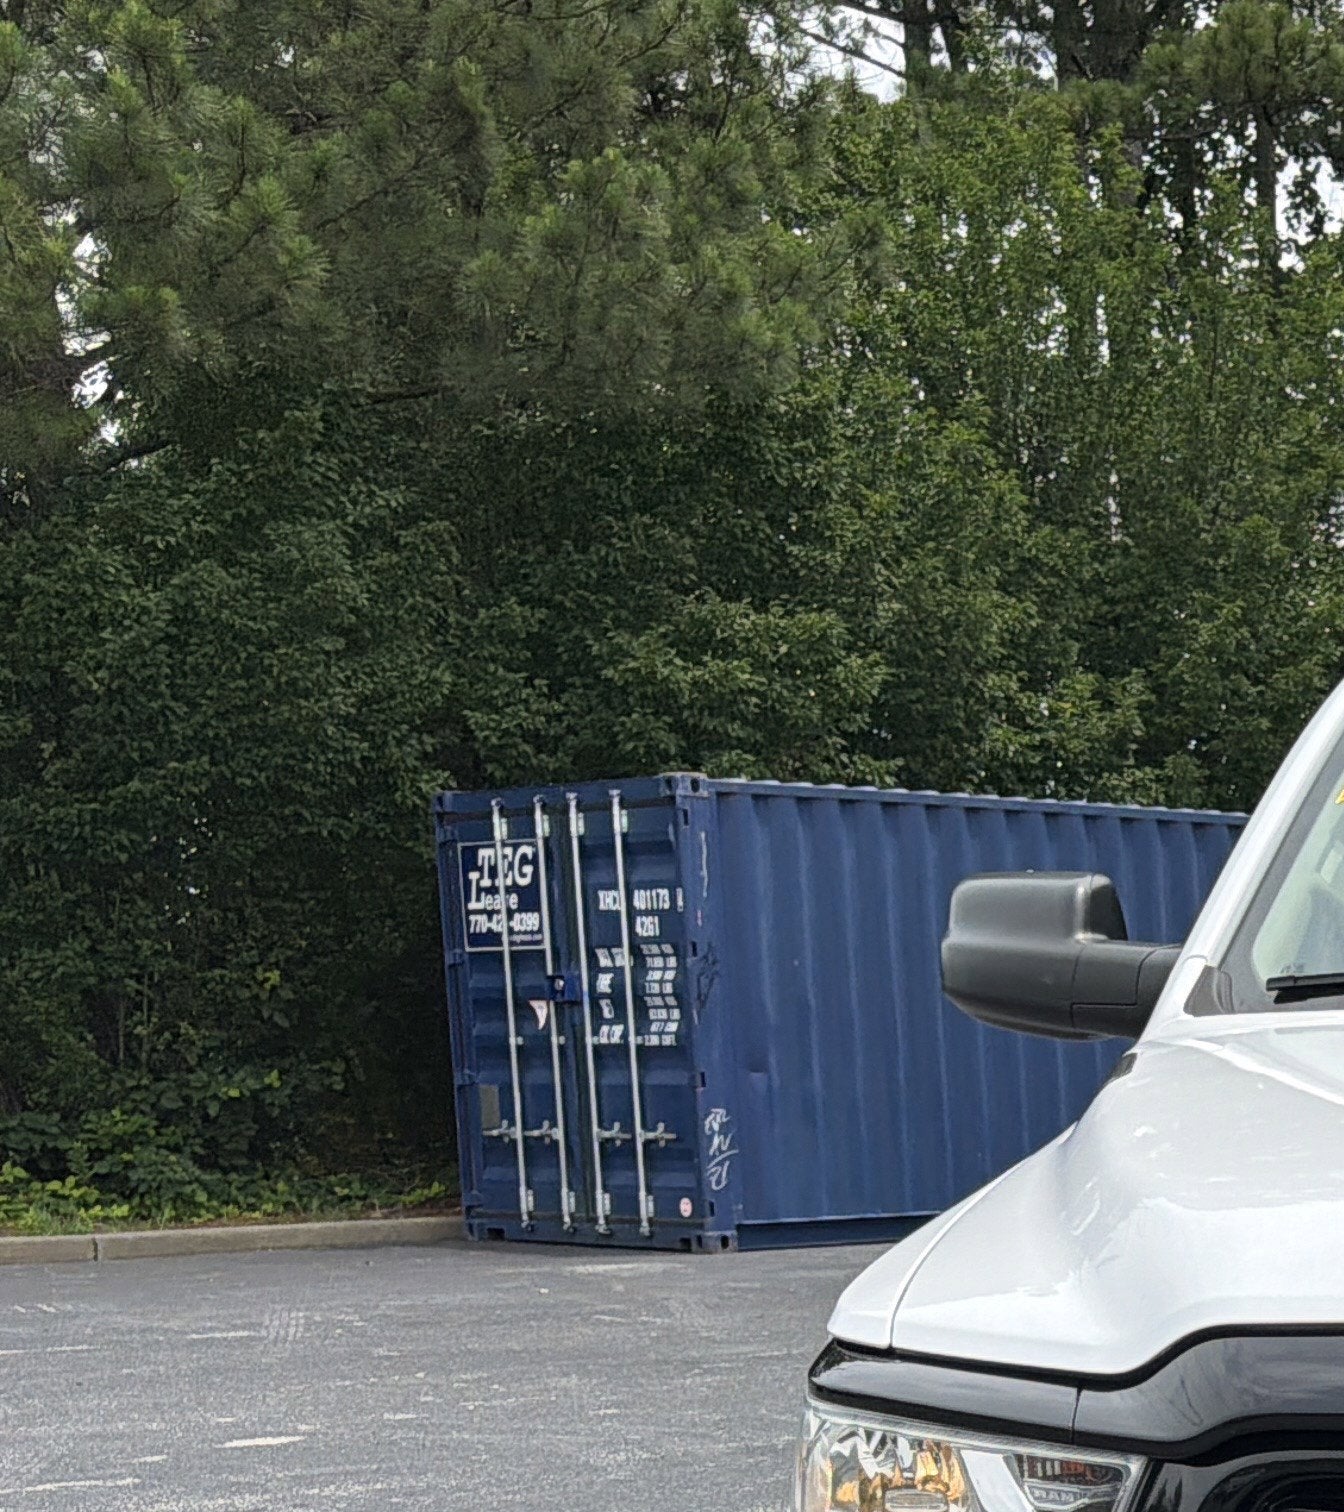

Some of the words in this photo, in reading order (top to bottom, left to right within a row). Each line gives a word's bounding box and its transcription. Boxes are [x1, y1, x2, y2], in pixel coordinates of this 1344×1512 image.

[467, 871, 518, 910] Leae
[468, 912, 540, 933] 770-42-0399
[1031, 1487, 1075, 1502] RAM
